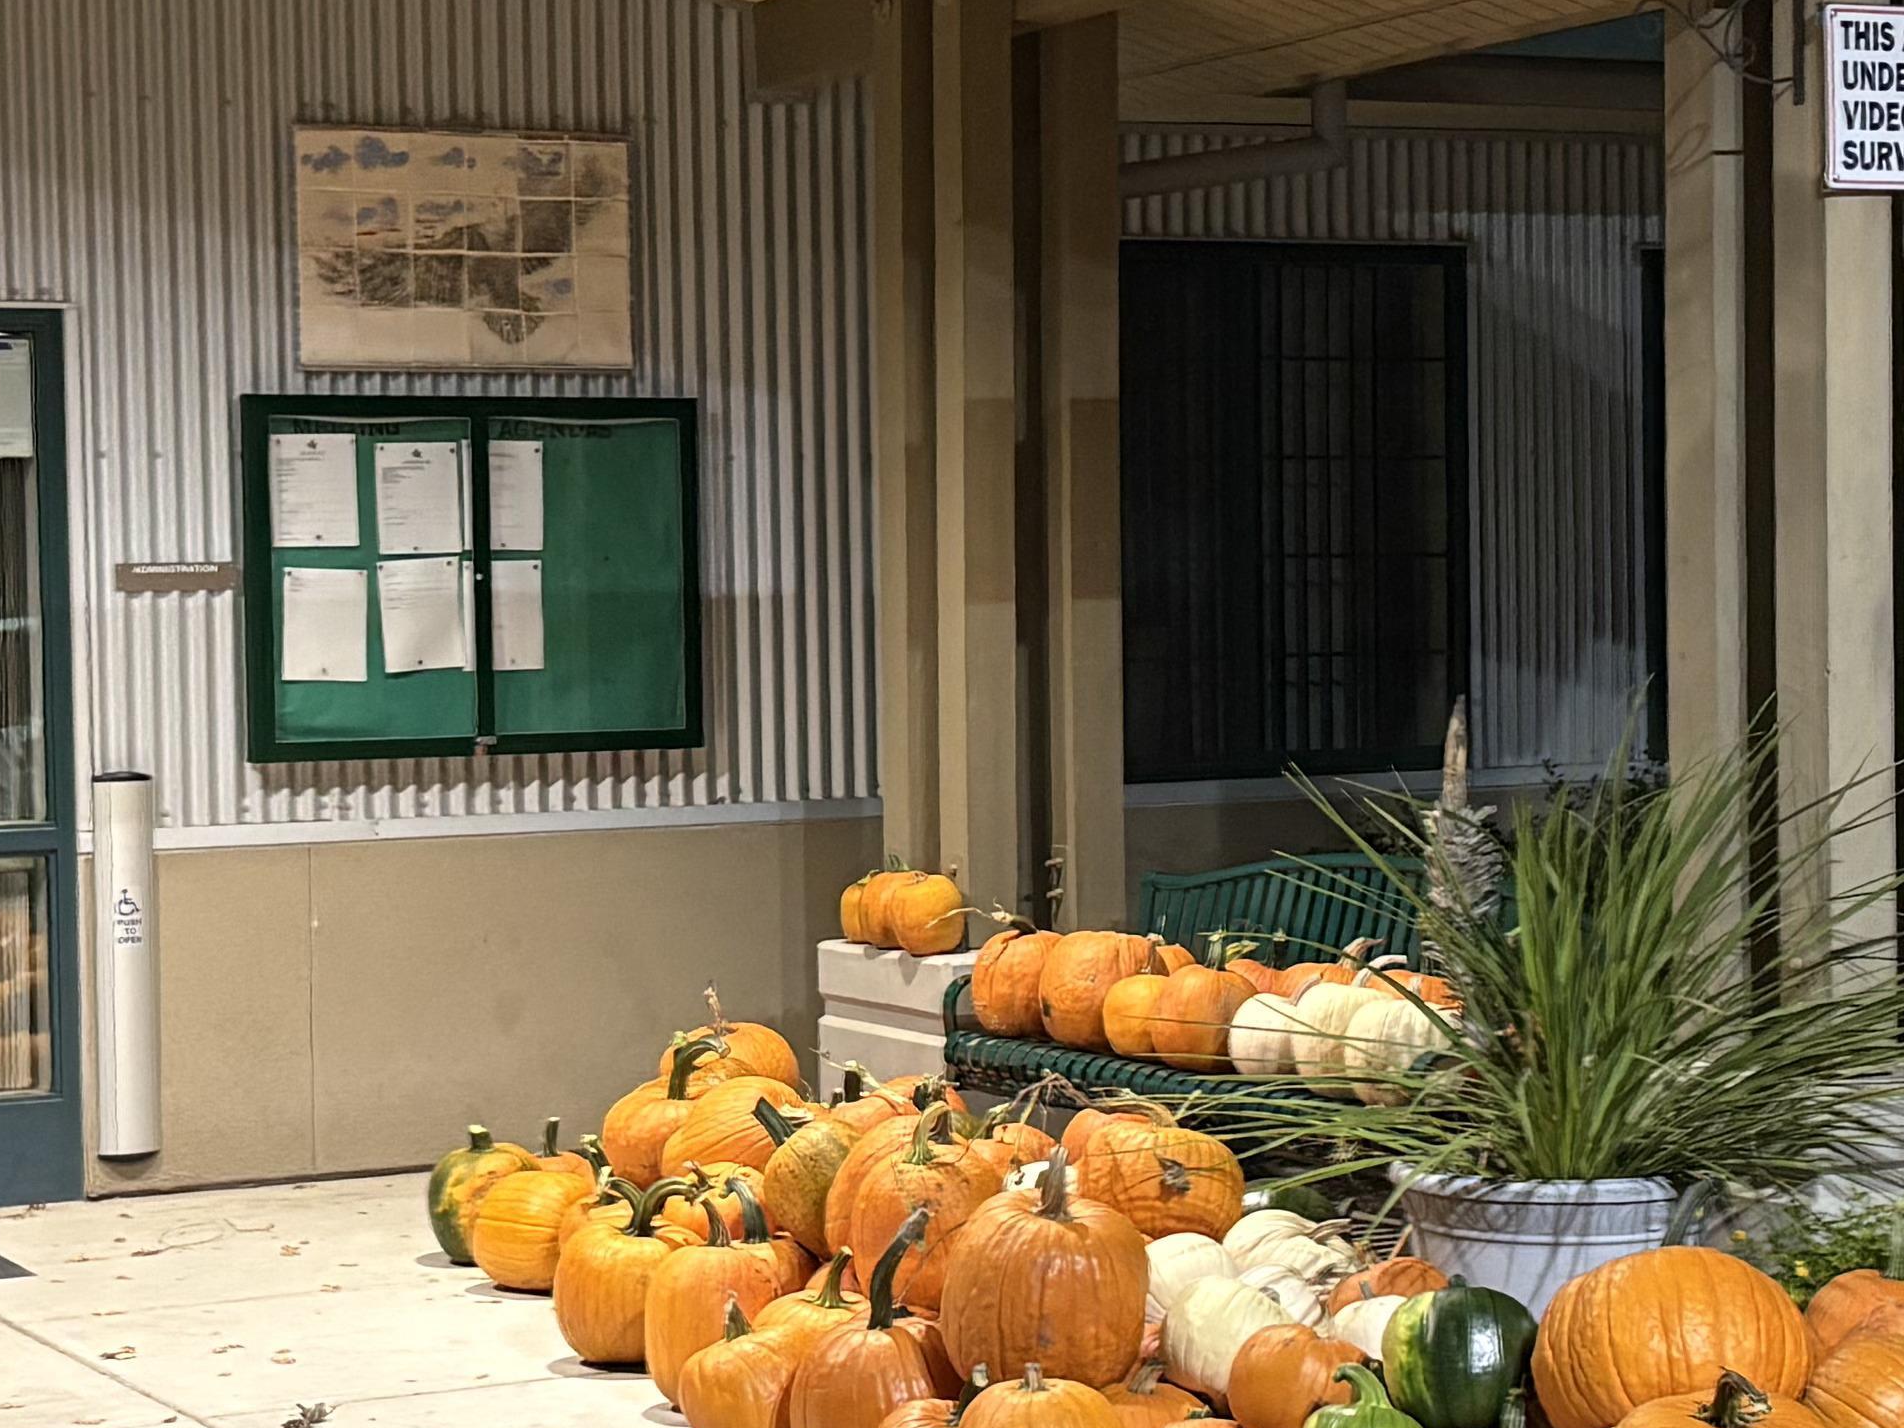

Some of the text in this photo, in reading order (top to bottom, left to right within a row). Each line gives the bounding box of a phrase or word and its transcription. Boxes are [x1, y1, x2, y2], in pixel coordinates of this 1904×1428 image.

[1840, 20, 1896, 52] THIS
[117, 918, 143, 926] PUSH
[124, 927, 137, 935] TO
[118, 936, 143, 944] OPEN
